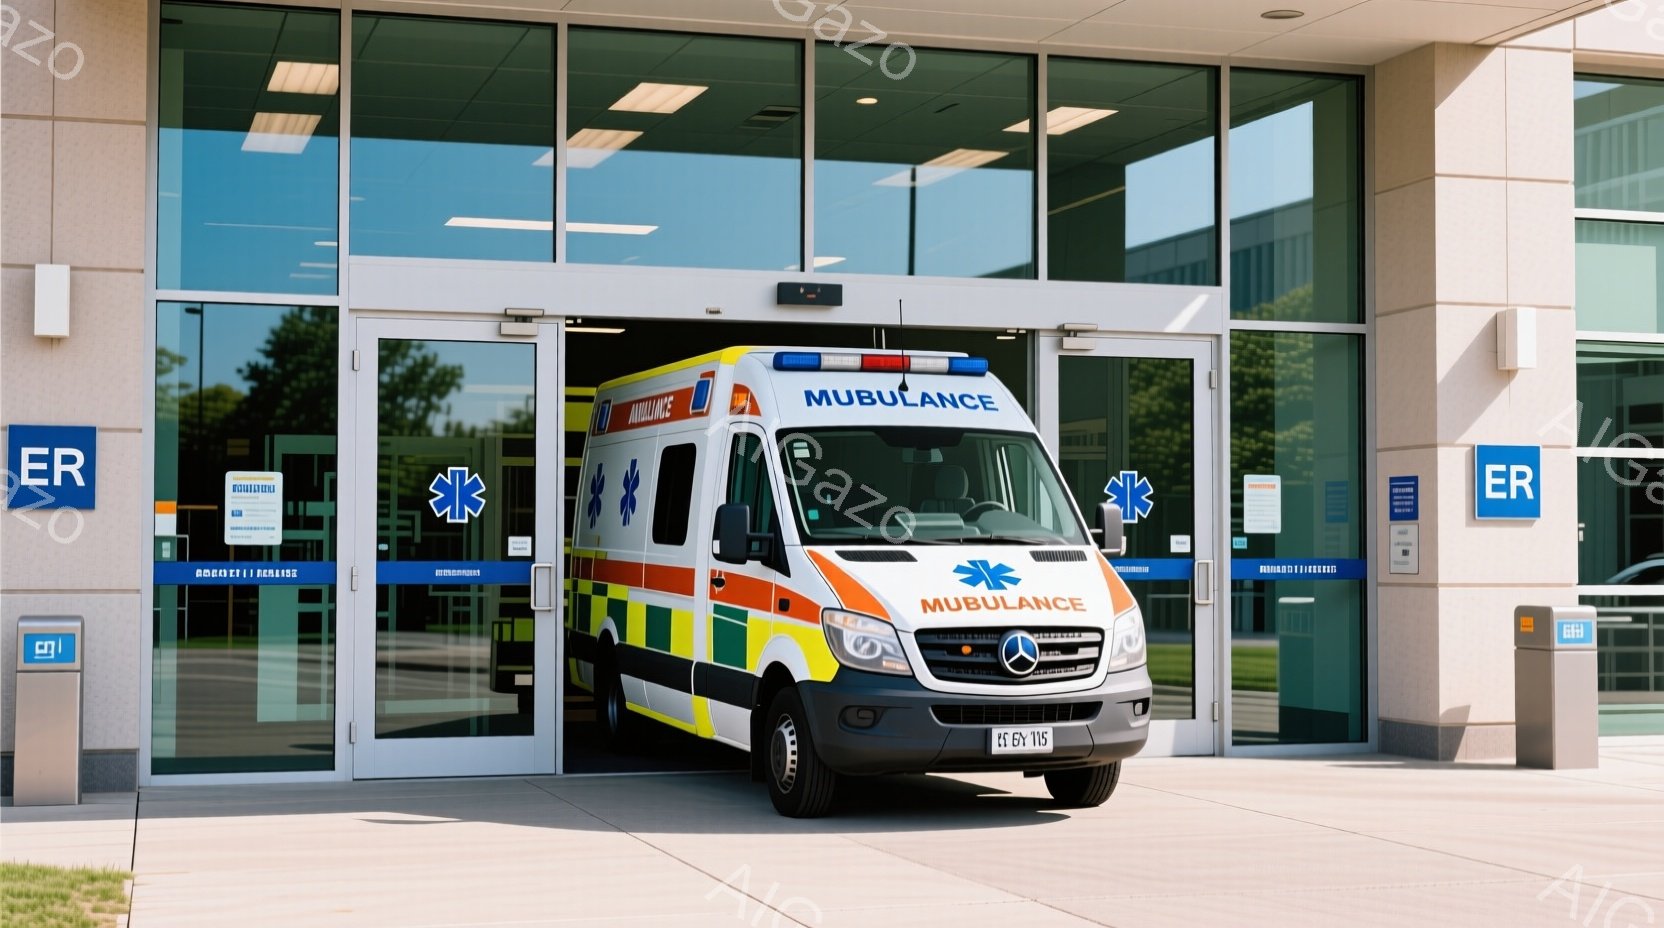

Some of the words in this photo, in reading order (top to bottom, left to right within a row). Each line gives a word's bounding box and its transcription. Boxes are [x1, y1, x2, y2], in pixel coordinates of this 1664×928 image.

[804, 389, 999, 412] MUBULANCE
[20, 447, 86, 487] ER
[1485, 464, 1535, 500] ER
[920, 595, 1087, 614] MUBULANCE
